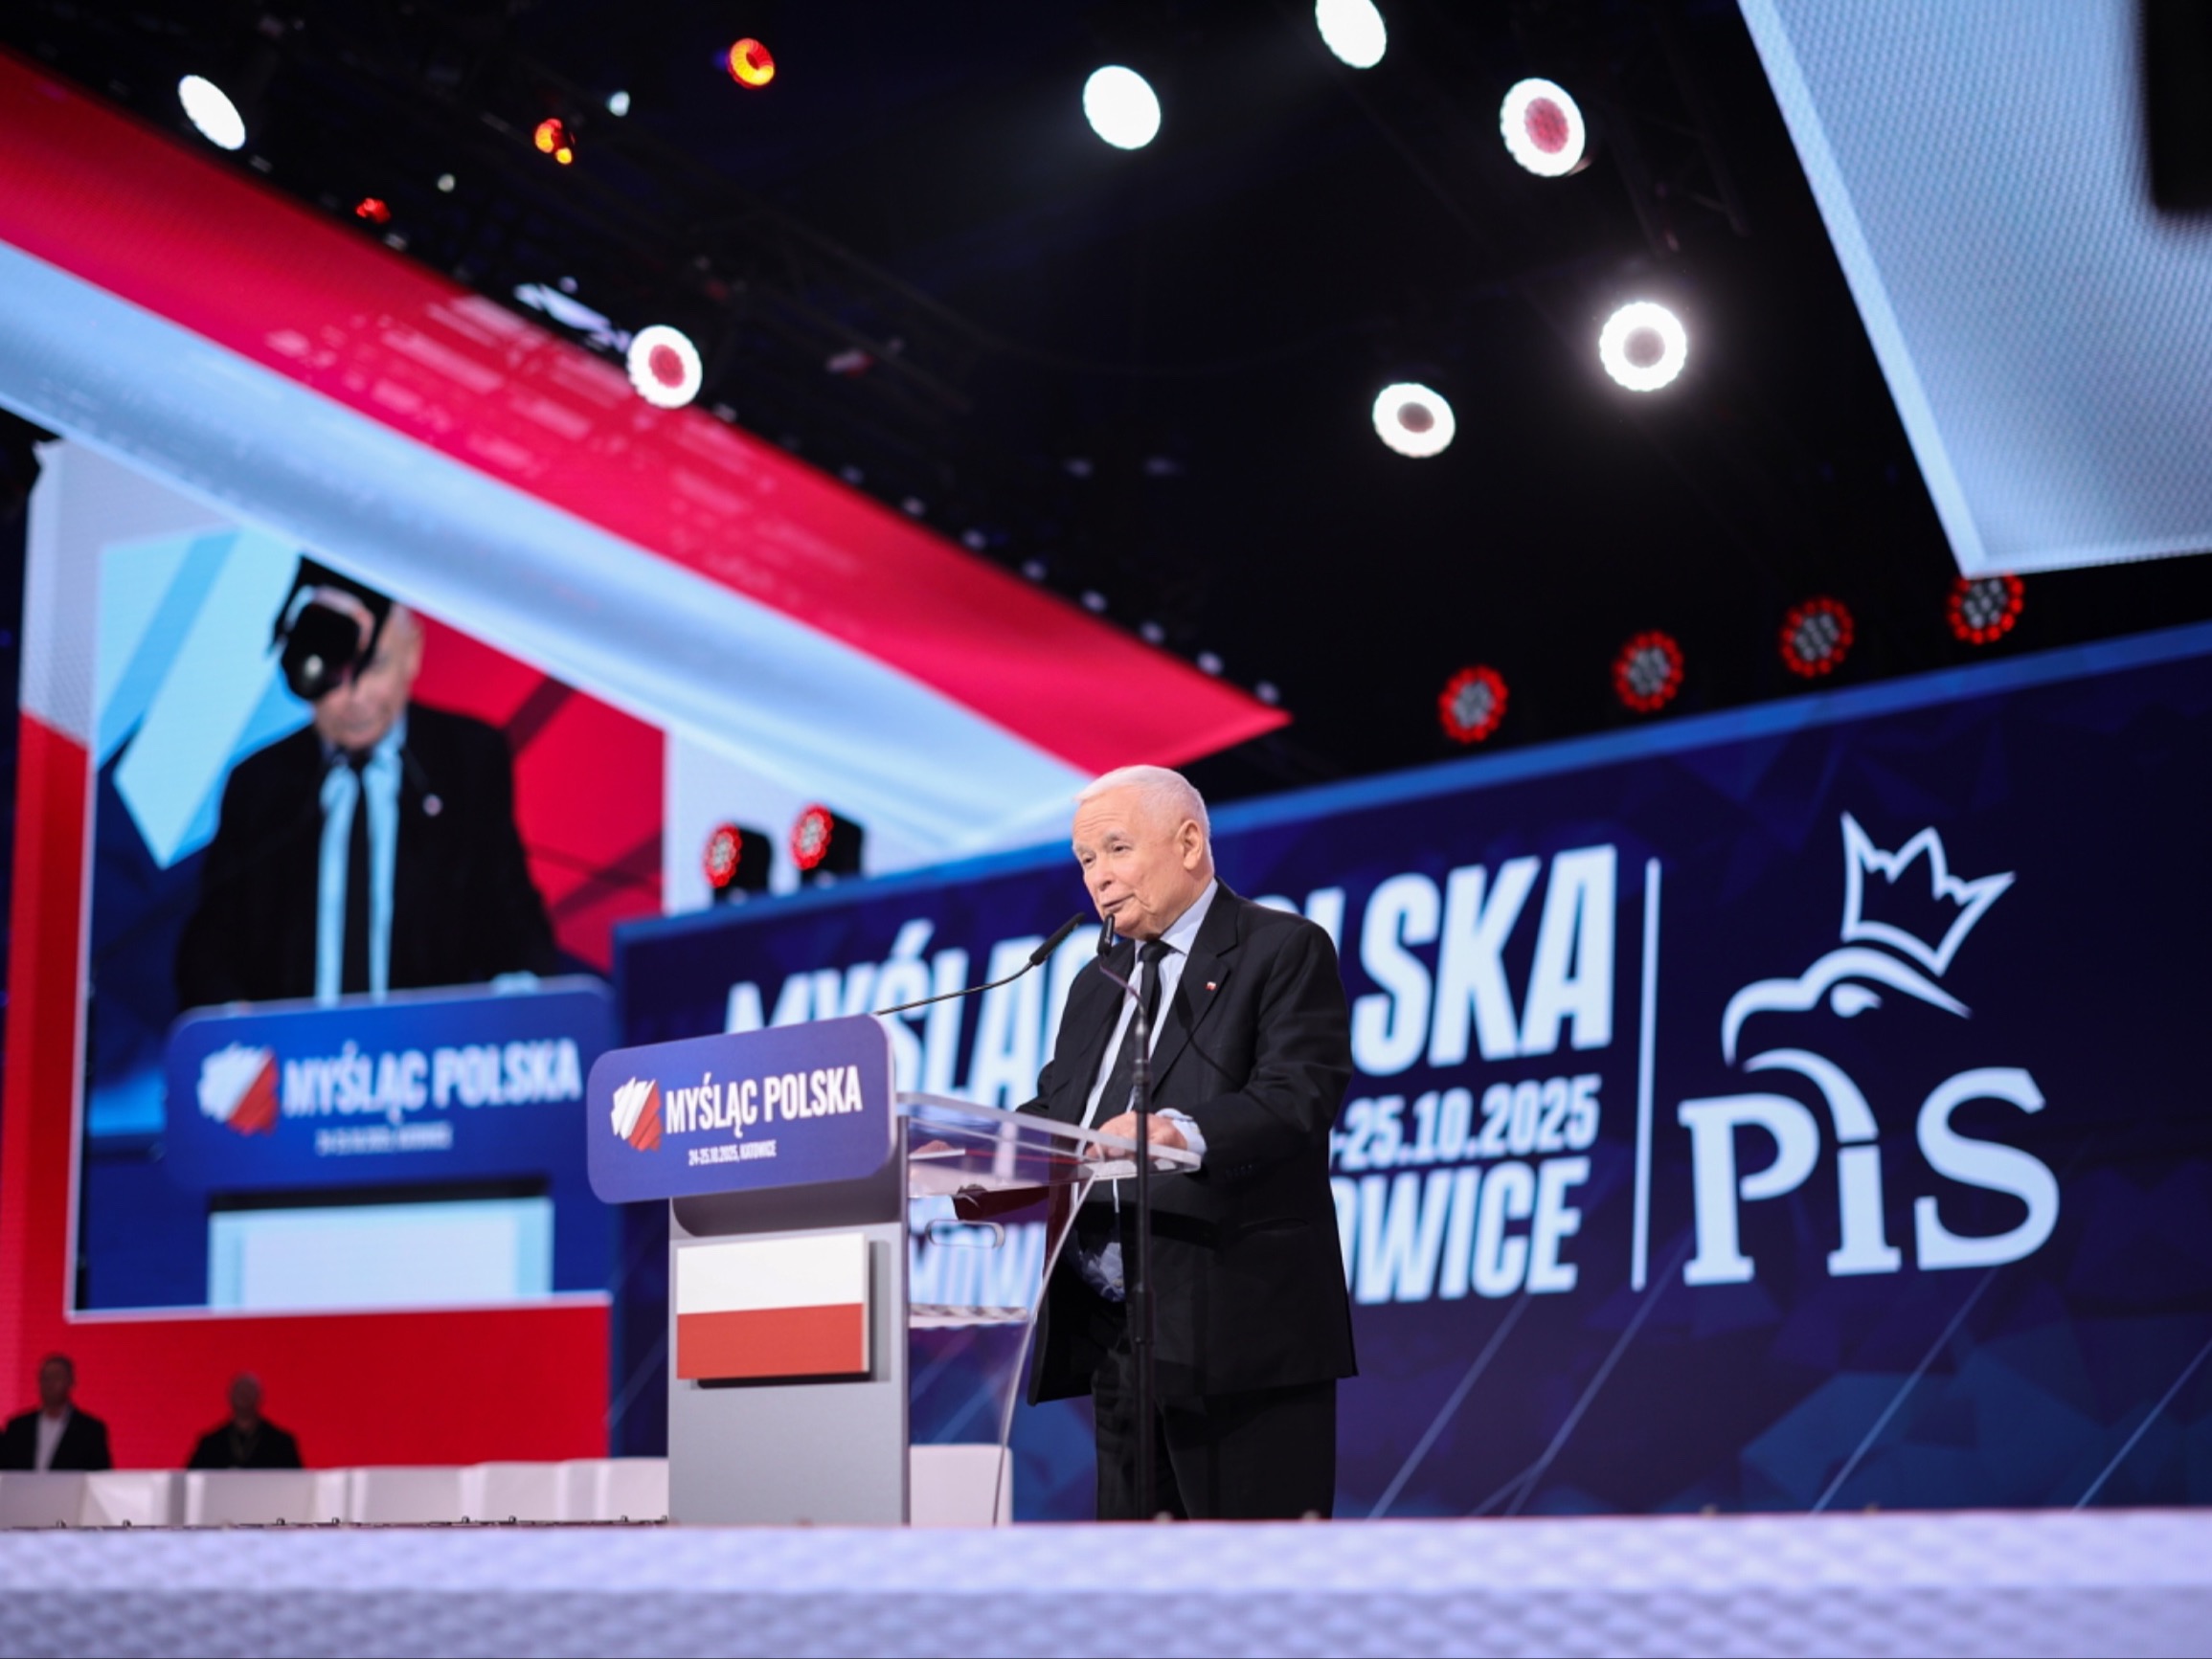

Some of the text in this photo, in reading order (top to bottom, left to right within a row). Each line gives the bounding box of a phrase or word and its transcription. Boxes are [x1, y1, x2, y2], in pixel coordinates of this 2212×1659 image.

[282, 1038, 582, 1124] MYŚLĄC POLSKA
[666, 1065, 863, 1138] MYŚLĄC POLSKA
[1677, 1065, 2061, 1287] PiS
